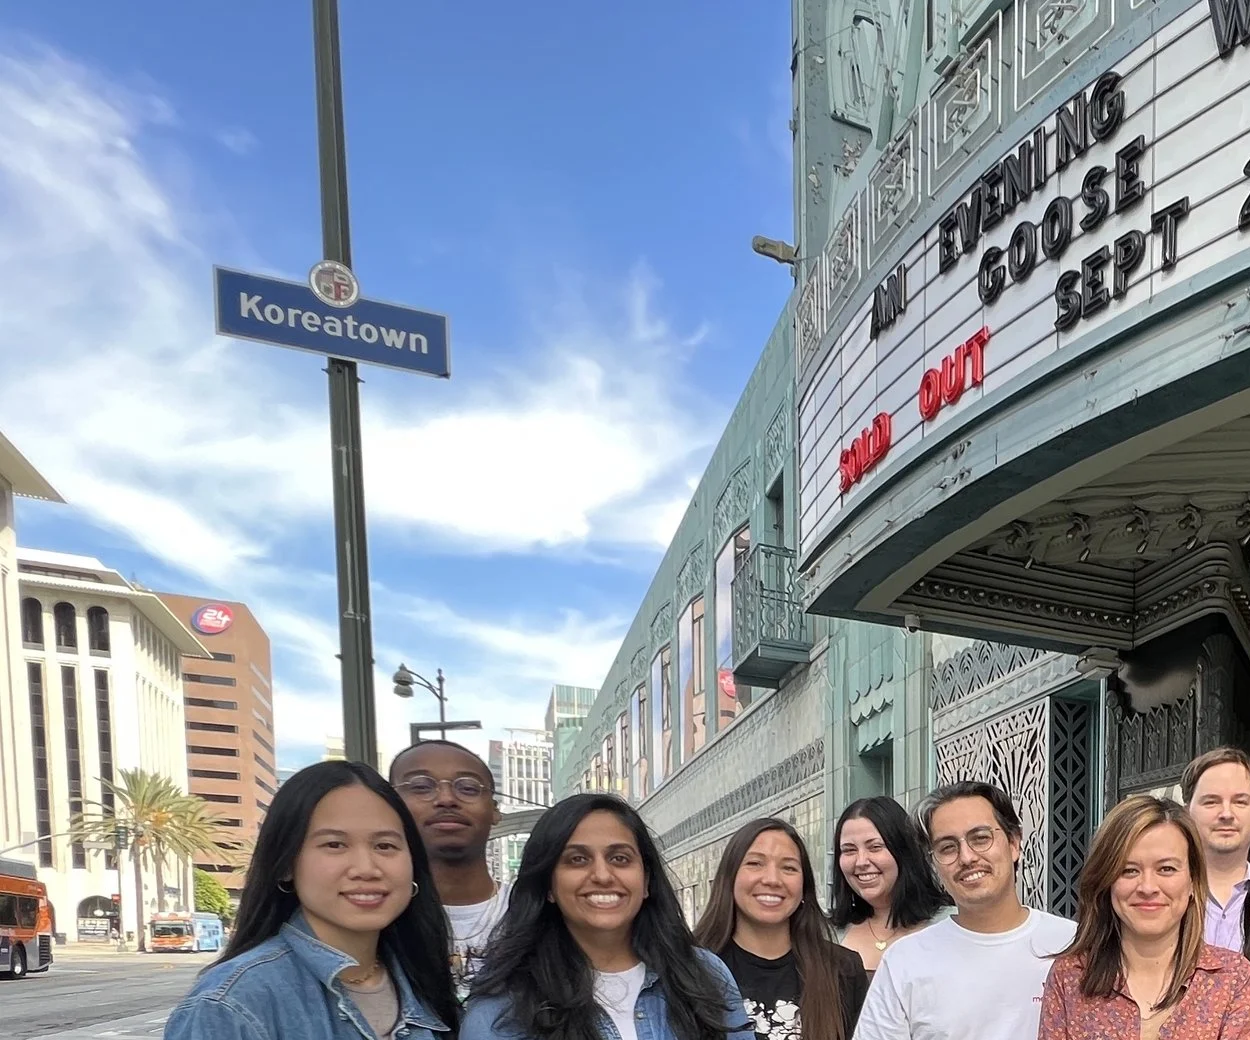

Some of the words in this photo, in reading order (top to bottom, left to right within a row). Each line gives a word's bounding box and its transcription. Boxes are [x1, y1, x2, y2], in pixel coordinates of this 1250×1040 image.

[870, 263, 906, 340] AN
[939, 71, 1125, 274] EVENING
[978, 135, 1145, 305] GOOSE
[239, 292, 428, 354] Koreatown
[839, 412, 892, 494] SOLD
[919, 326, 990, 421] OUT
[1054, 196, 1190, 332] SEPT
[202, 608, 231, 625] 24
